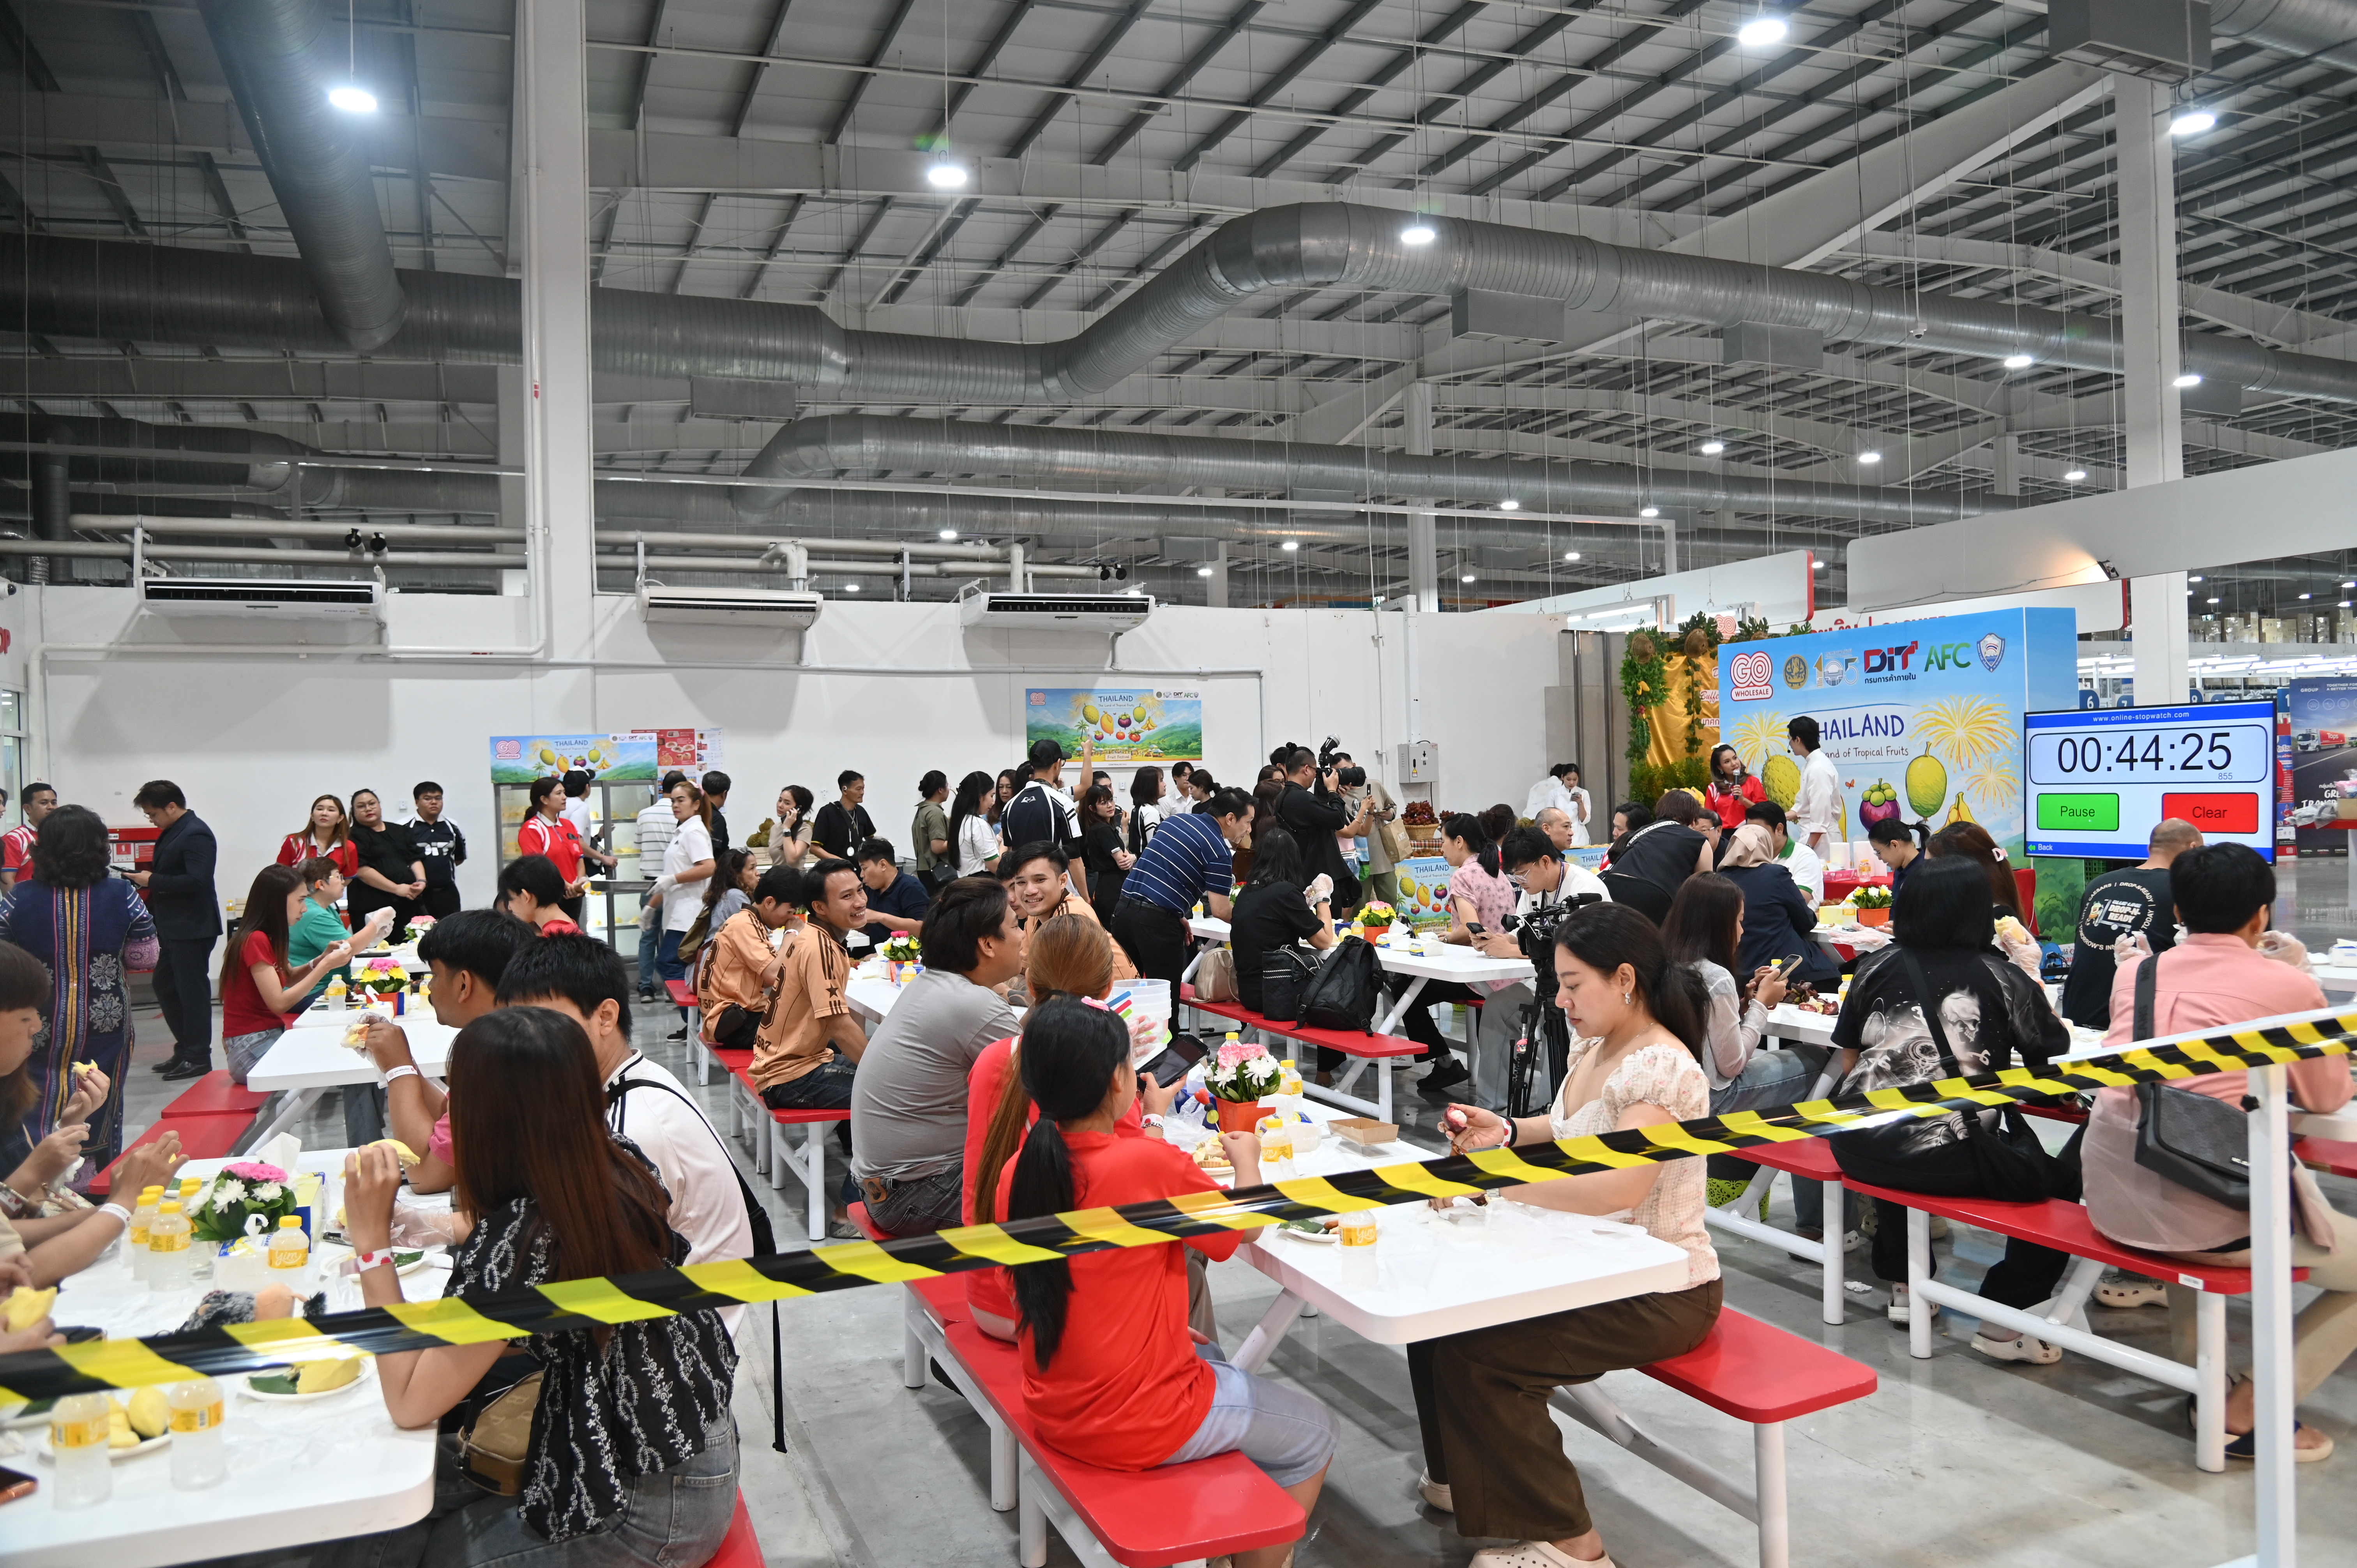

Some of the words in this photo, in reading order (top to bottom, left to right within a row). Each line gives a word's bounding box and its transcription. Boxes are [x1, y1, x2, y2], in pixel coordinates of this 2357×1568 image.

[1924, 642, 1971, 672] AFC
[1730, 651, 1773, 688] GO
[1864, 673, 1916, 684] กรมการค้าภายใน
[1030, 692, 1046, 702] GO
[1735, 689, 1769, 697] WHOLESALE
[2087, 696, 2094, 709] 6
[2093, 712, 2189, 722] www.online-stopwatch.com
[1816, 713, 1904, 742] HAILAND
[496, 740, 521, 754] GO
[1824, 749, 1840, 759] and
[1843, 748, 1851, 758] of
[1853, 747, 1883, 760] Tropical
[1886, 746, 1909, 756] Fruits
[2058, 732, 2232, 773] 00:44:25
[2060, 806, 2096, 818] Pause
[2192, 807, 2227, 819] Clear
[1415, 864, 1449, 874] THAILAND
[2088, 883, 2112, 901] CAESARS
[2119, 882, 2154, 902] DROP-N-READY
[2108, 904, 2141, 916] DROP-N-
[2107, 912, 2136, 923] READY
[2079, 923, 2104, 950] TOMORROW'S
[2141, 909, 2154, 929] TODAY
